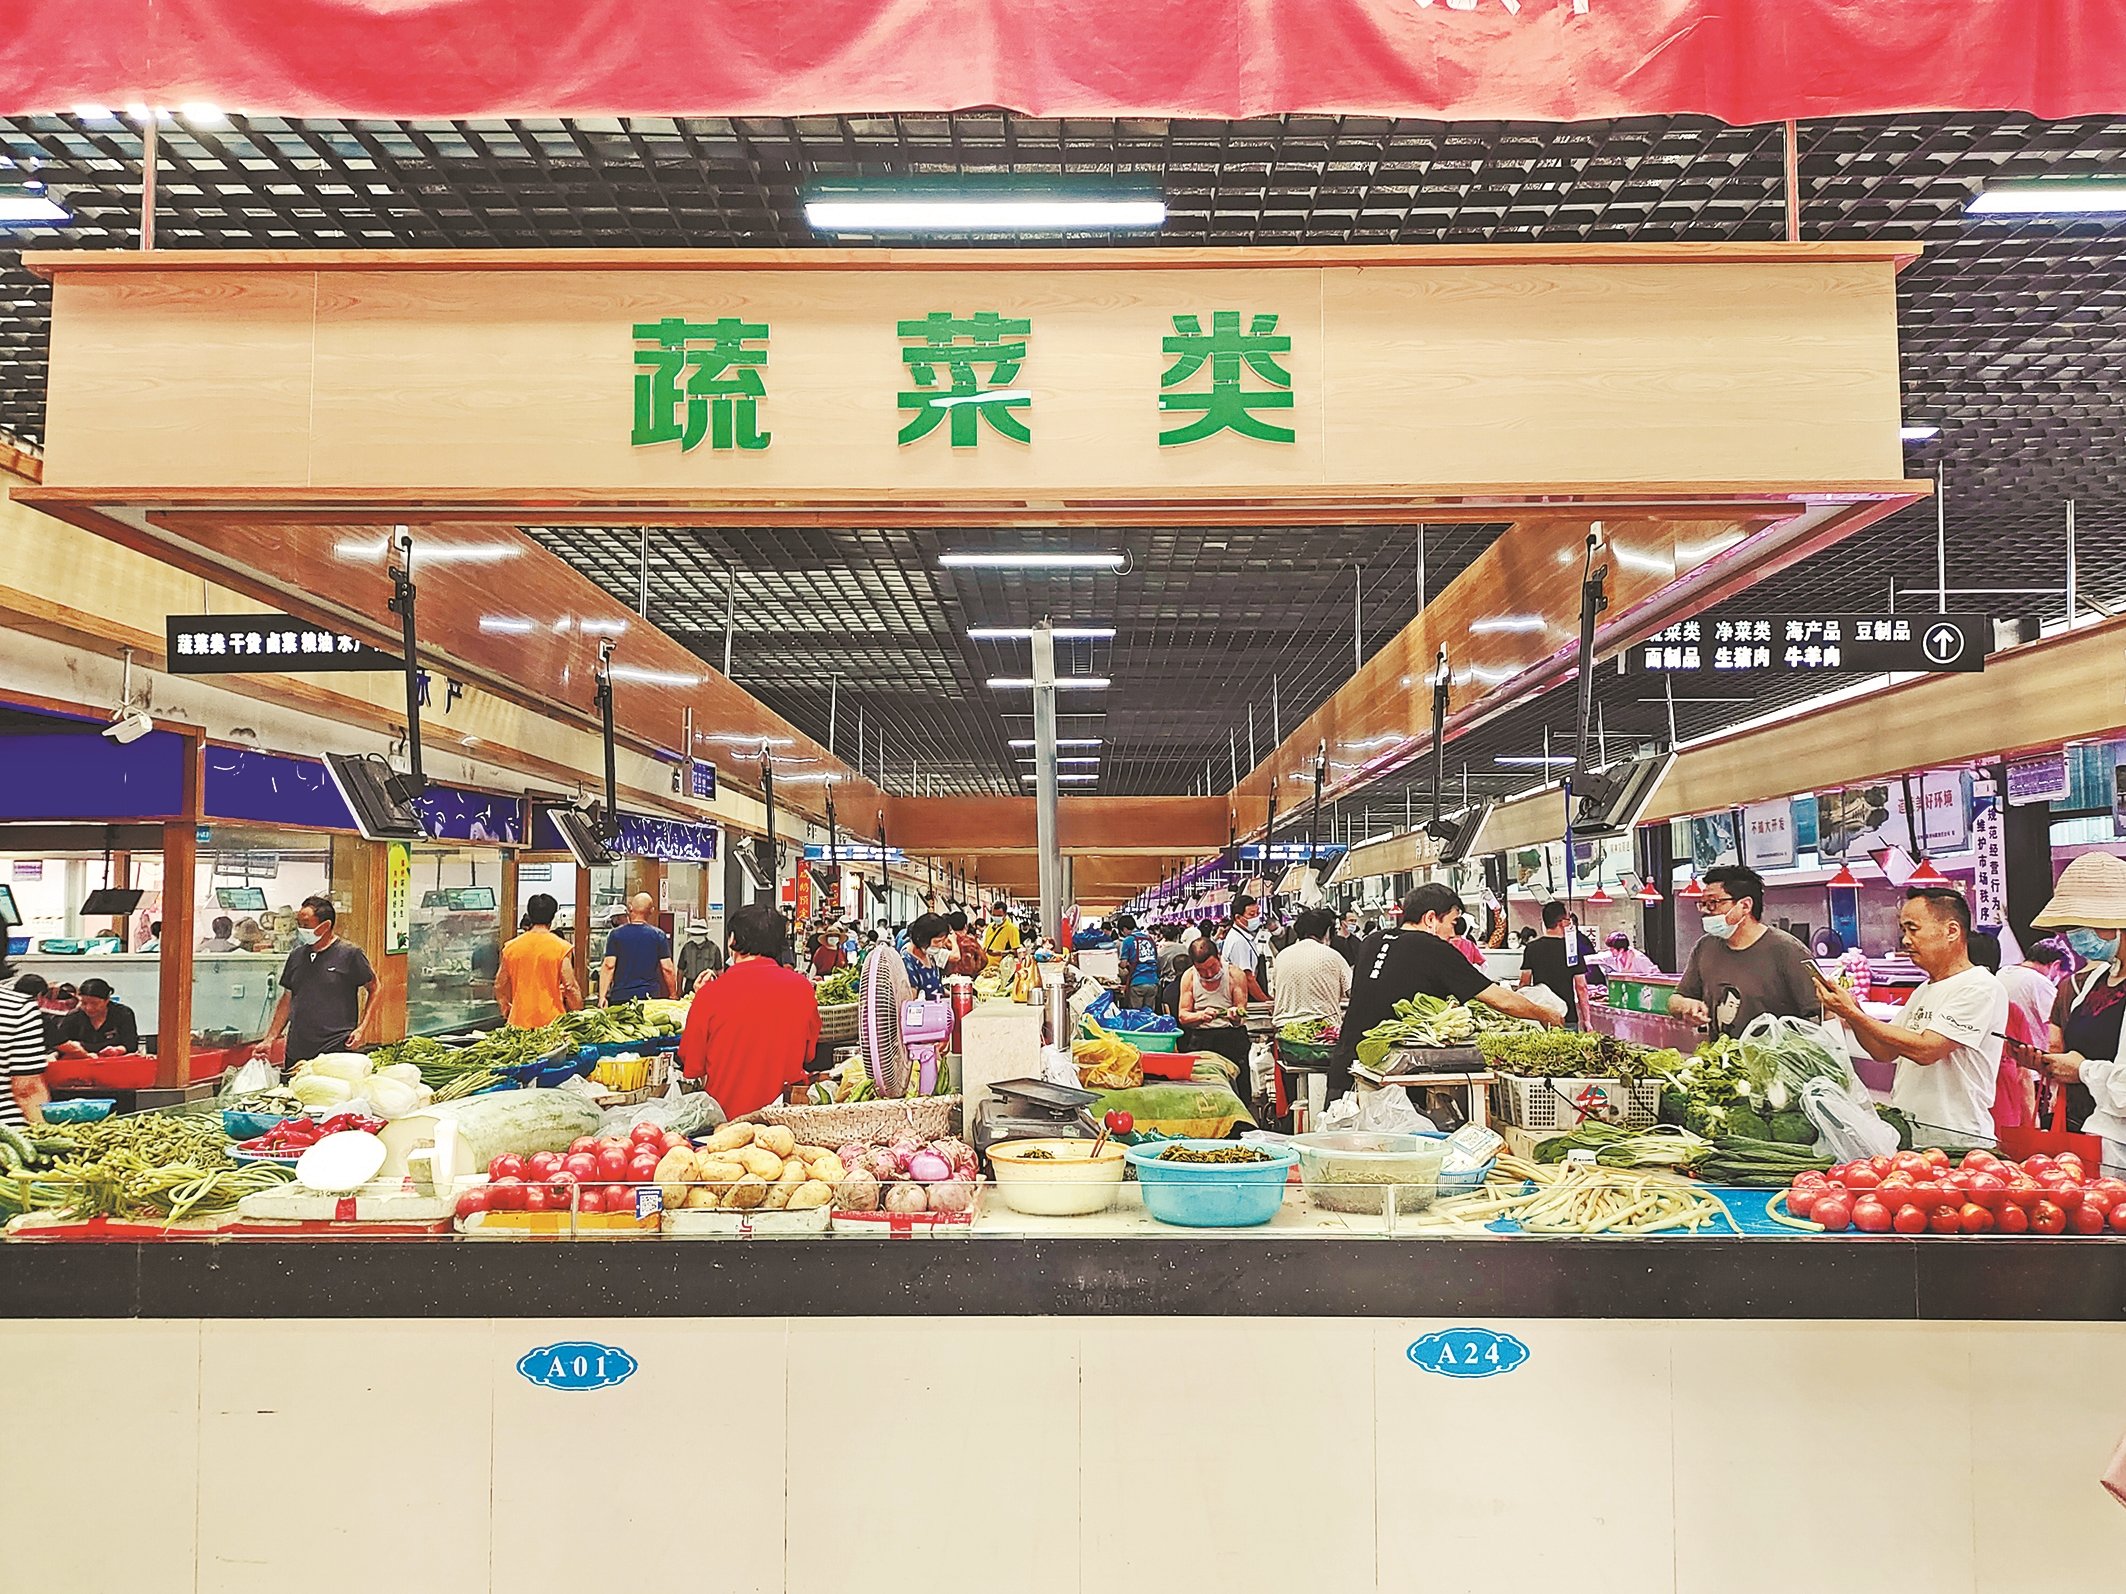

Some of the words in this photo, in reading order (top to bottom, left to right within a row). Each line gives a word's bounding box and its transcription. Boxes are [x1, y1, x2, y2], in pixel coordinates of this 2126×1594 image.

[631, 311, 1296, 453] 蔬菜类
[1714, 620, 1772, 642] 净菜类
[1784, 620, 1842, 642] 海产品
[1854, 620, 1911, 642] 豆制品
[177, 632, 226, 655] 蔬菜类
[1644, 646, 1701, 669] 面制品
[1714, 645, 1771, 668] 生猪肉
[1784, 645, 1841, 668] 牛羊肉
[1976, 819, 1990, 921] 维护市场秩序
[1987, 808, 2001, 911] 规范经营行为
[1437, 1342, 1500, 1365] A24
[546, 1355, 607, 1378] A01
